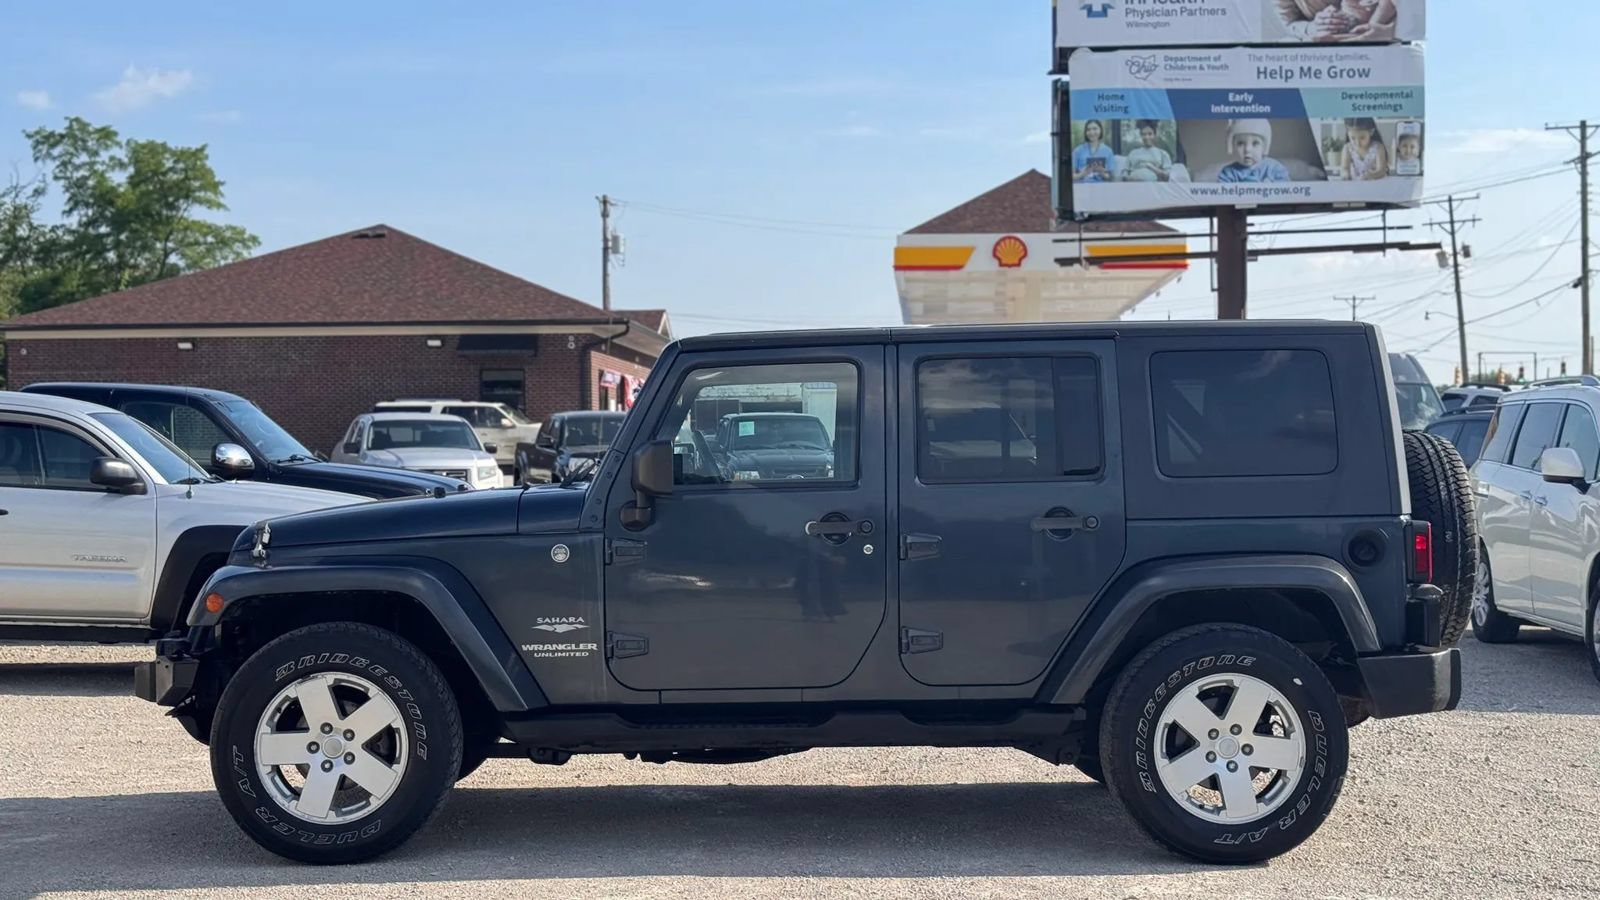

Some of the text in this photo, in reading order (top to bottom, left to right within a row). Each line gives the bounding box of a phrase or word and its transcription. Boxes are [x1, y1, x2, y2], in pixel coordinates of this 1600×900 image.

[1125, 6, 1227, 19] Physician Partners
[1163, 54, 1222, 63] Department of
[1247, 54, 1264, 62] The
[1265, 54, 1288, 62] heart
[1289, 53, 1298, 62] of
[1299, 53, 1334, 63] thriving
[1164, 63, 1198, 71] Children
[1206, 63, 1229, 71] Youth
[1256, 65, 1372, 83] Help Me Grow
[1097, 92, 1125, 102] Home
[1228, 92, 1254, 104] Early
[1341, 90, 1414, 102] Developmental
[1093, 104, 1129, 114] Visiting
[1211, 103, 1271, 113] Intervention
[1351, 101, 1404, 113] Screenings
[1190, 185, 1311, 198] www.helpmegrow.org
[537, 616, 585, 624] SAHARA
[521, 643, 598, 651] WRANGLER
[275, 652, 429, 762] BRIDGESTONE
[1135, 654, 1257, 794] BRIDGESTONE
[1213, 710, 1328, 845] DUELER A/T
[232, 743, 383, 845] DUELER A/T
